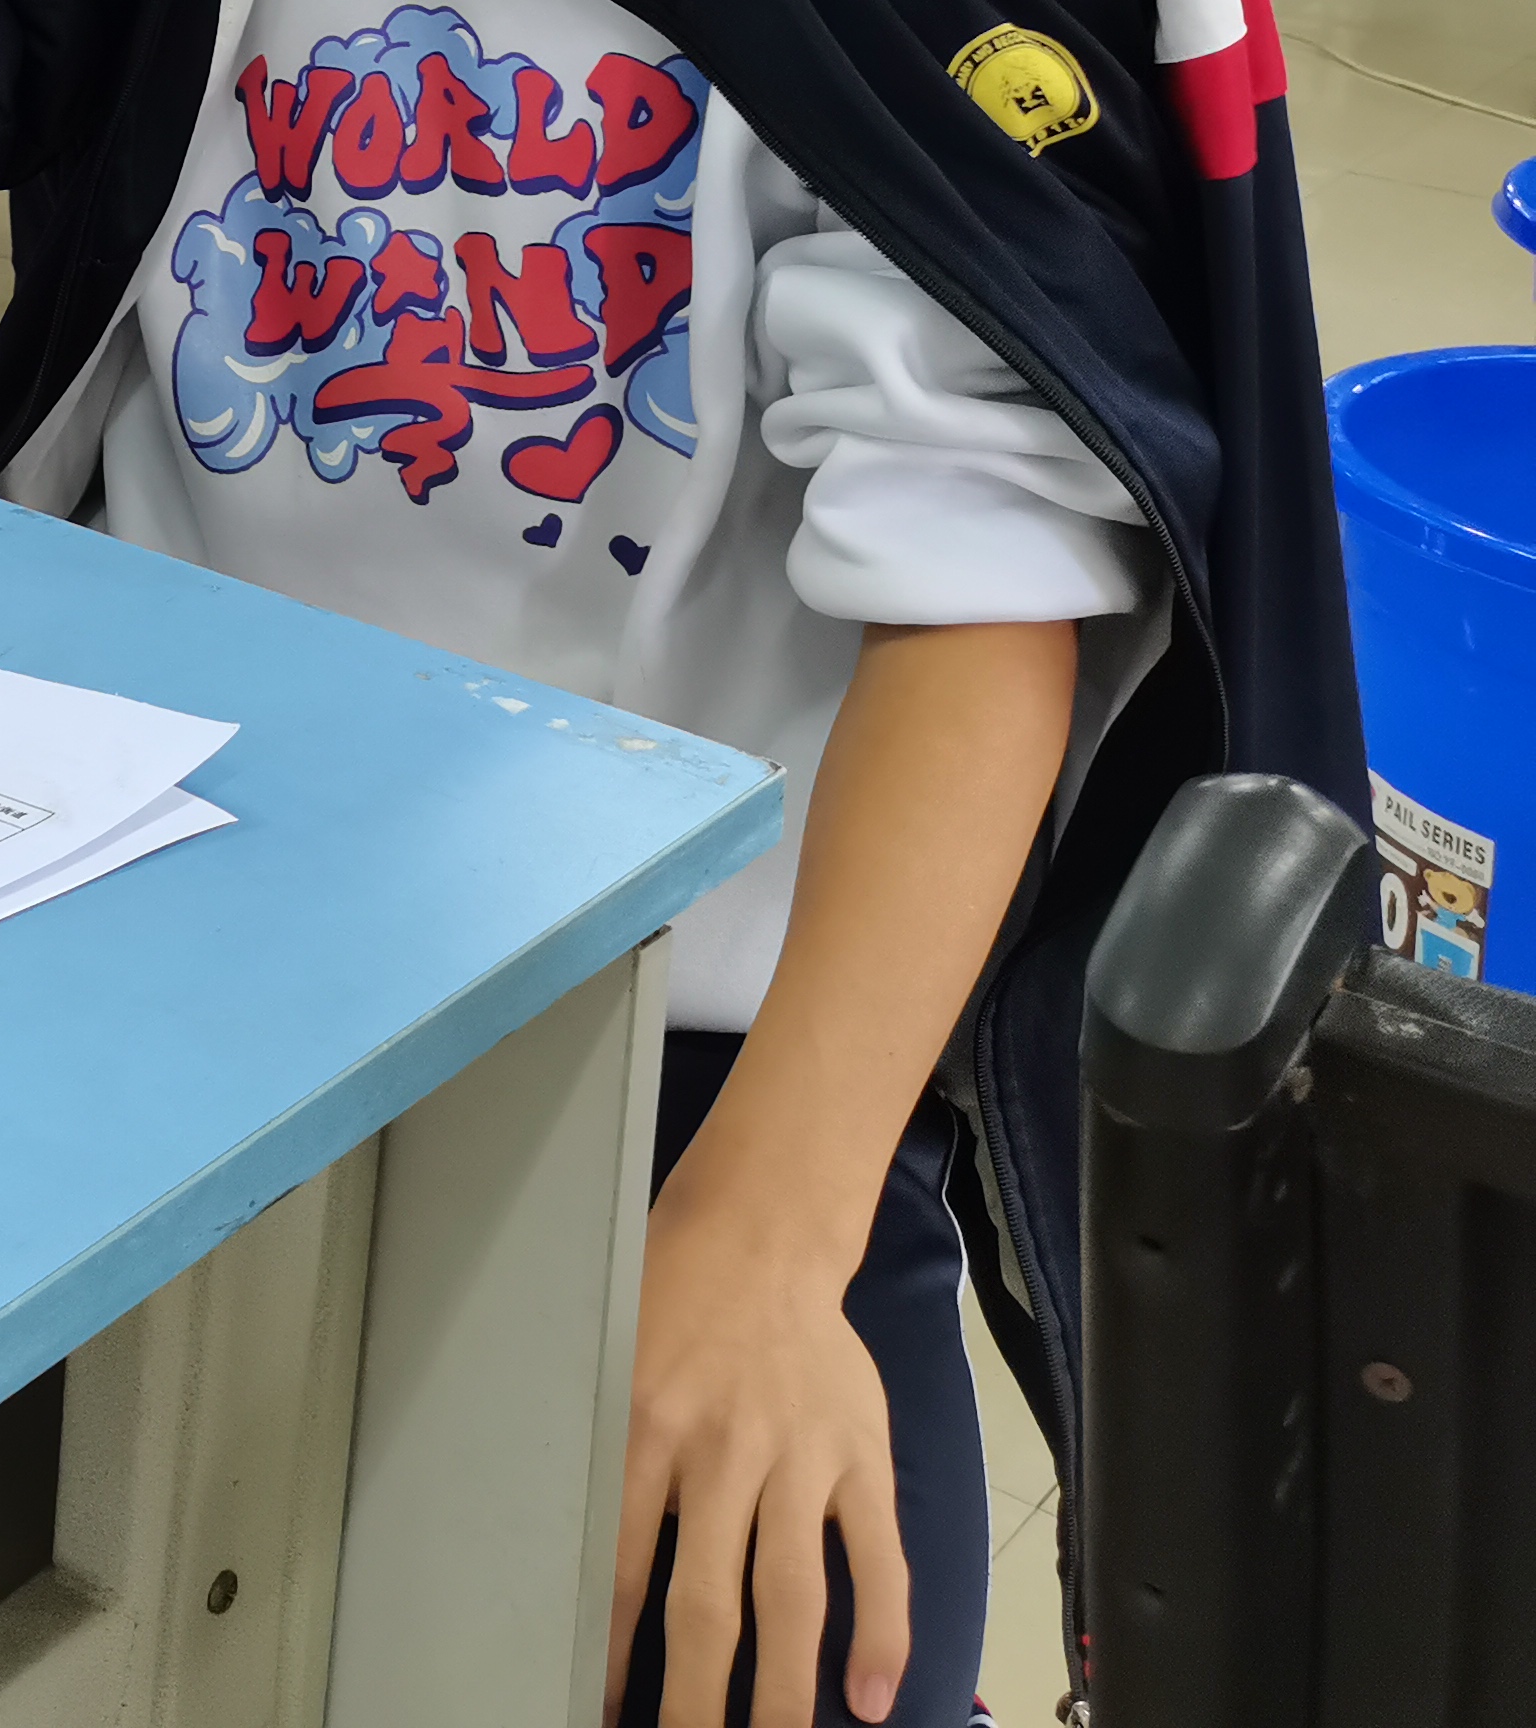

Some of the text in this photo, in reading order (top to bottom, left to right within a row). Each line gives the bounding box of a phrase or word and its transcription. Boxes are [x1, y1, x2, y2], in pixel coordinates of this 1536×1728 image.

[234, 51, 698, 201] WORLD
[1384, 795, 1416, 832] PAIL
[1421, 819, 1487, 865] SERIES
